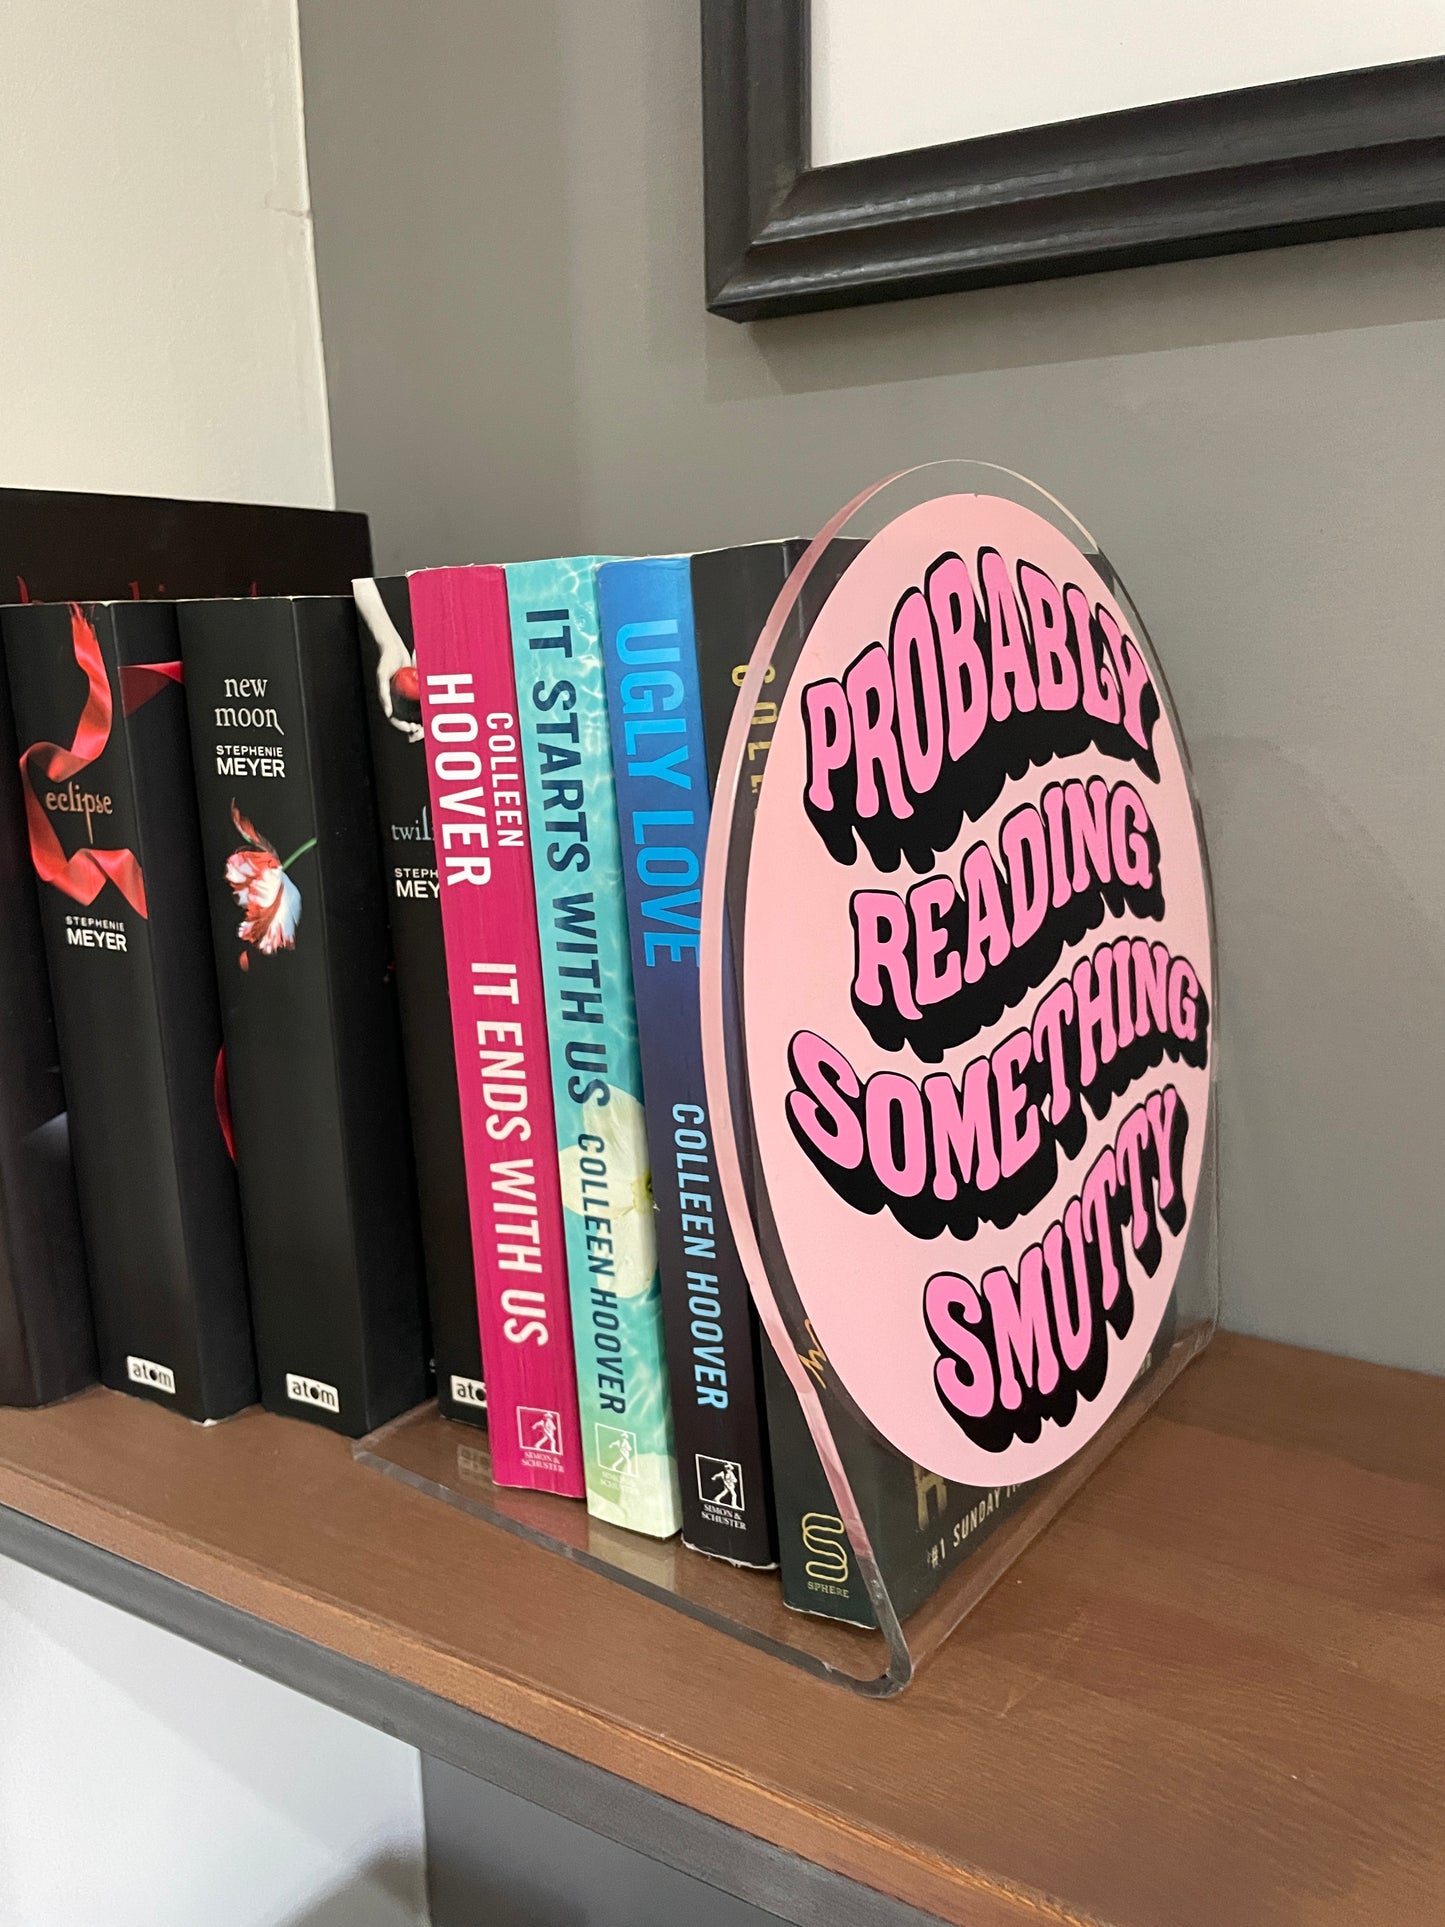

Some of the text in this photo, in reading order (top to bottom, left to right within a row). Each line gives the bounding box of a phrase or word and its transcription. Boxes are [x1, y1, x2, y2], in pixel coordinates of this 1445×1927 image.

[224, 676, 268, 698] new
[802, 547, 1159, 848] PROBABLY
[214, 707, 285, 736] moon
[215, 745, 284, 758] STEPHENIE
[216, 757, 286, 779] MEYER
[426, 673, 492, 887] HOOVER
[486, 711, 525, 848] COLLEEN
[615, 618, 701, 969] UGLY LOVE
[45, 781, 113, 845] eclipse
[391, 804, 435, 841] twil
[526, 608, 611, 1108] IT STARTS WITH US
[65, 915, 126, 932] STEPHENIE
[66, 928, 128, 952] MEYER
[849, 776, 1164, 1048] READING
[786, 934, 1207, 1230] SOMETHING
[471, 962, 550, 1347] IT ENDS WITH US
[577, 1132, 627, 1415] COLLEEN HOOVER
[672, 1103, 729, 1410] COLLEEN HOOVER
[922, 1082, 1186, 1442] SMUTTY
[133, 1361, 174, 1390] atom
[290, 1379, 337, 1408] atom
[701, 1511, 747, 1530] SCHUSTER
[703, 1503, 742, 1521] SIMON &
[953, 1487, 1001, 1548] SUNDAY
[807, 1581, 850, 1599] SPHERE
